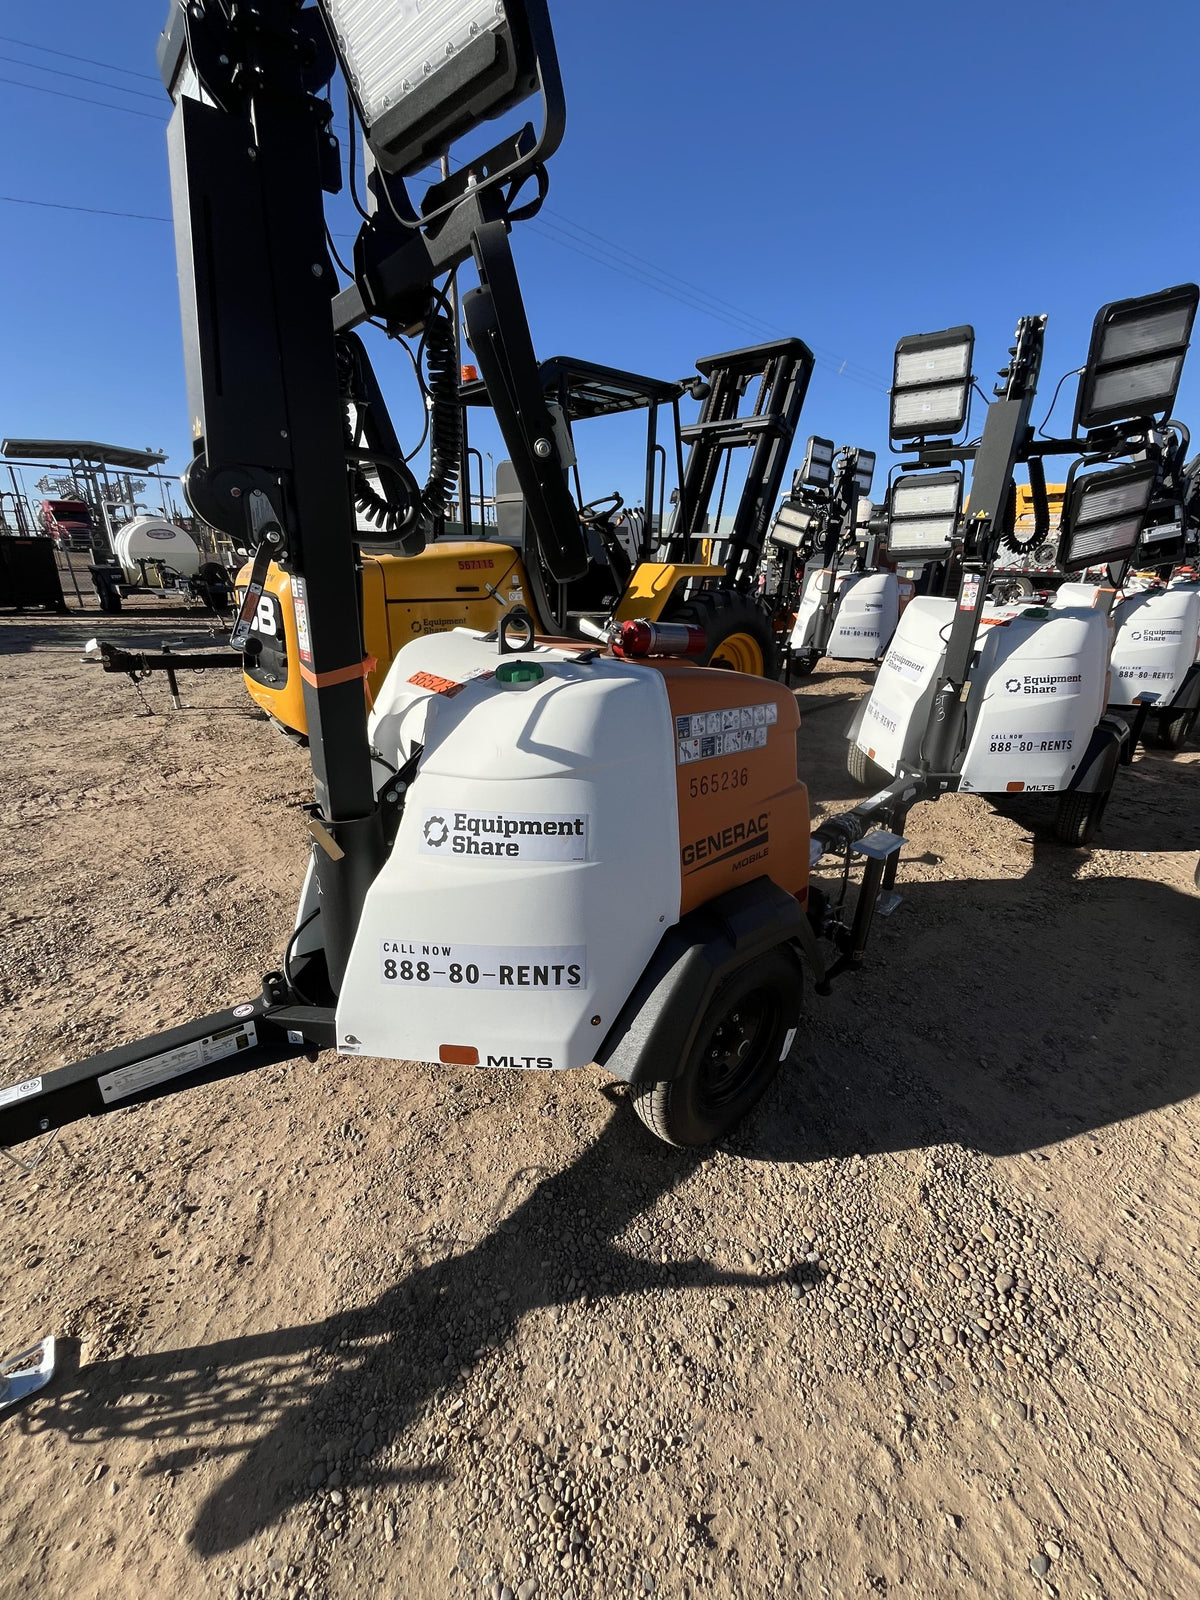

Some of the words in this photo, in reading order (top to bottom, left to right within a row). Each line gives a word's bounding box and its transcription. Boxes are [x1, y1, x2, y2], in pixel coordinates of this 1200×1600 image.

[423, 618, 467, 626] Equipment
[1023, 674, 1082, 686] Equipment
[1119, 670, 1174, 679] 888-80-RENTS
[1023, 685, 1057, 694] Share
[990, 740, 1073, 752] 888-80-RENTS
[690, 767, 748, 798] 565236
[1026, 784, 1055, 792] MLTS
[453, 813, 584, 838] Equipment
[452, 835, 520, 857] Share
[682, 813, 769, 866] GENERAC
[731, 848, 769, 872] MOBILE
[383, 942, 415, 954] CALL
[422, 945, 452, 957] NOW
[384, 958, 581, 986] 888-80-RENTS
[487, 1055, 553, 1069] MLTS
